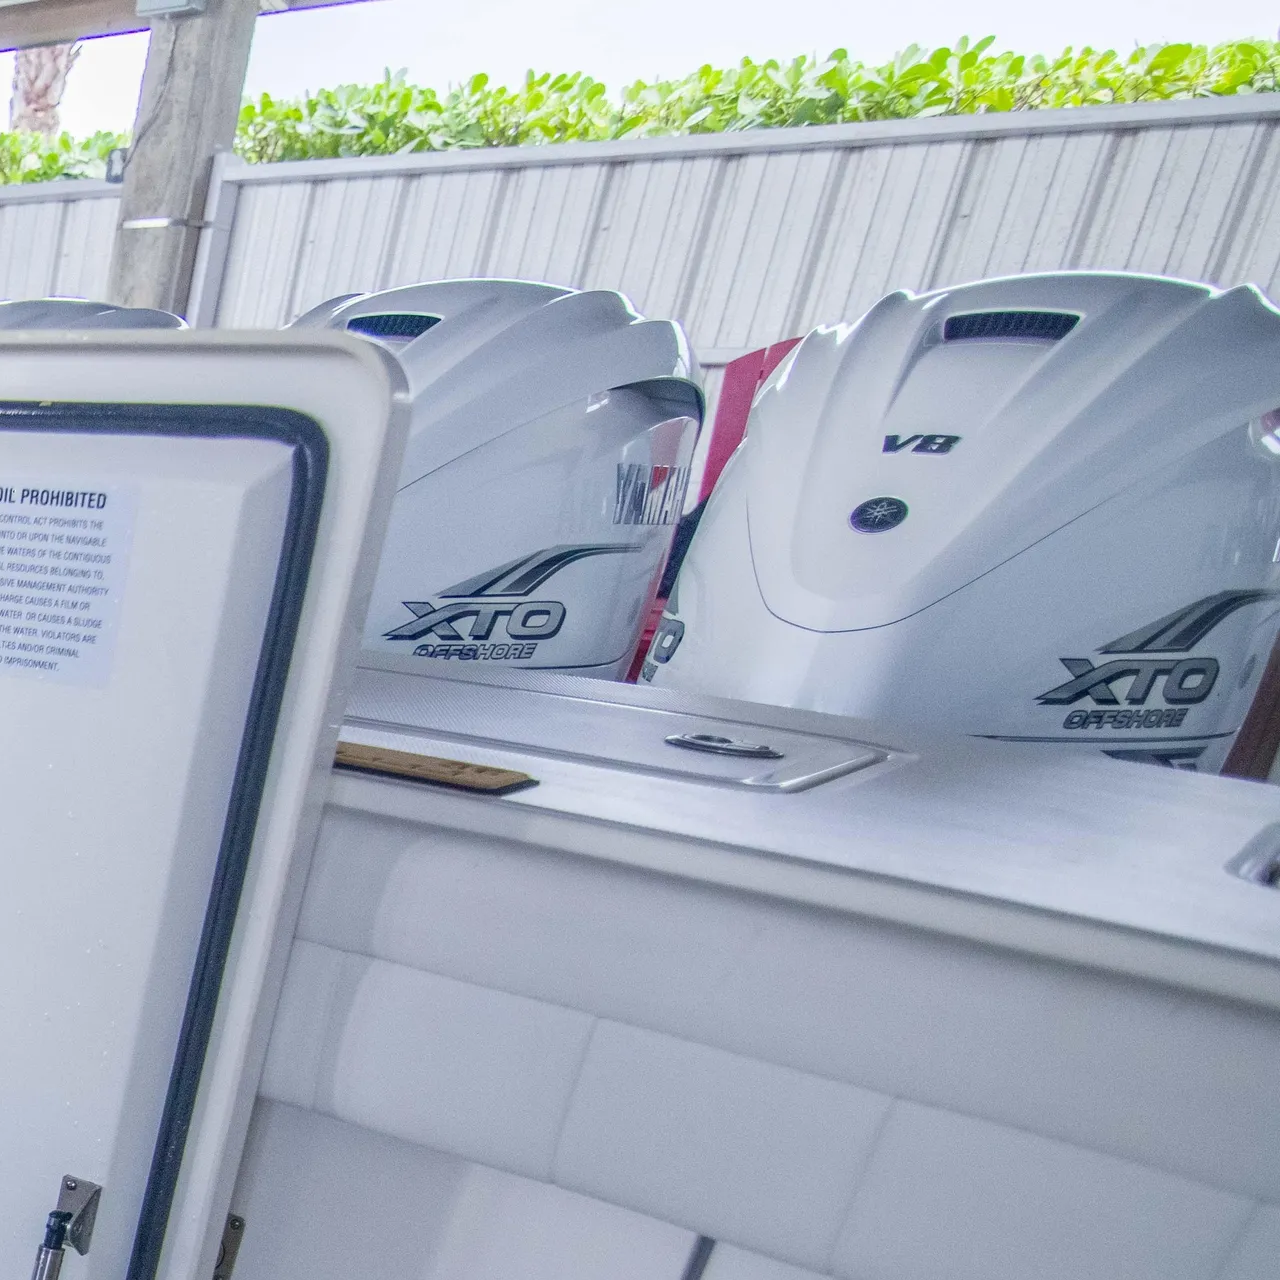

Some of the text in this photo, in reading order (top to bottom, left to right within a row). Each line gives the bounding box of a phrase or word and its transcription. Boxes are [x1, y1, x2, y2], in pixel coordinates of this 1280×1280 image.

[882, 434, 962, 456] V8
[20, 489, 107, 509] PROHIBITED
[612, 462, 691, 526] YAMAH
[0, 514, 31, 524] CONTROL
[34, 517, 47, 526] ACT
[49, 517, 88, 529] PROHIBITS
[90, 520, 104, 531] THE
[0, 531, 15, 539] INTO
[17, 532, 27, 540] OR
[29, 533, 49, 542] UPON
[51, 535, 64, 544] THE
[66, 535, 107, 547] NAVIGABLE
[7, 547, 36, 558] WATERS
[38, 549, 47, 558] OF
[49, 550, 62, 559] THE
[63, 551, 112, 564] CONTIGUOUS
[7, 562, 49, 575] RESOURCES
[50, 566, 90, 579] BELONGING
[17, 580, 66, 592] MANAGEMENT
[67, 584, 109, 596] AUTHORITY
[25, 596, 53, 608] CAUSES
[61, 600, 78, 610] FILM
[79, 602, 90, 611] OR
[25, 612, 36, 621] OR
[38, 613, 66, 624] CAUSES
[67, 616, 72, 625] A
[74, 616, 102, 629] SLUDGE
[382, 601, 566, 640] XTO
[0, 625, 12, 634] THE
[41, 630, 80, 642] VIOLATORS
[82, 635, 96, 644] ARE
[17, 642, 44, 653] AND/OR
[46, 646, 80, 658] CRIMINAL
[413, 643, 538, 660] OFFSHORE
[1032, 658, 1220, 705] XTO
[1062, 708, 1189, 729] OFFSHORE
